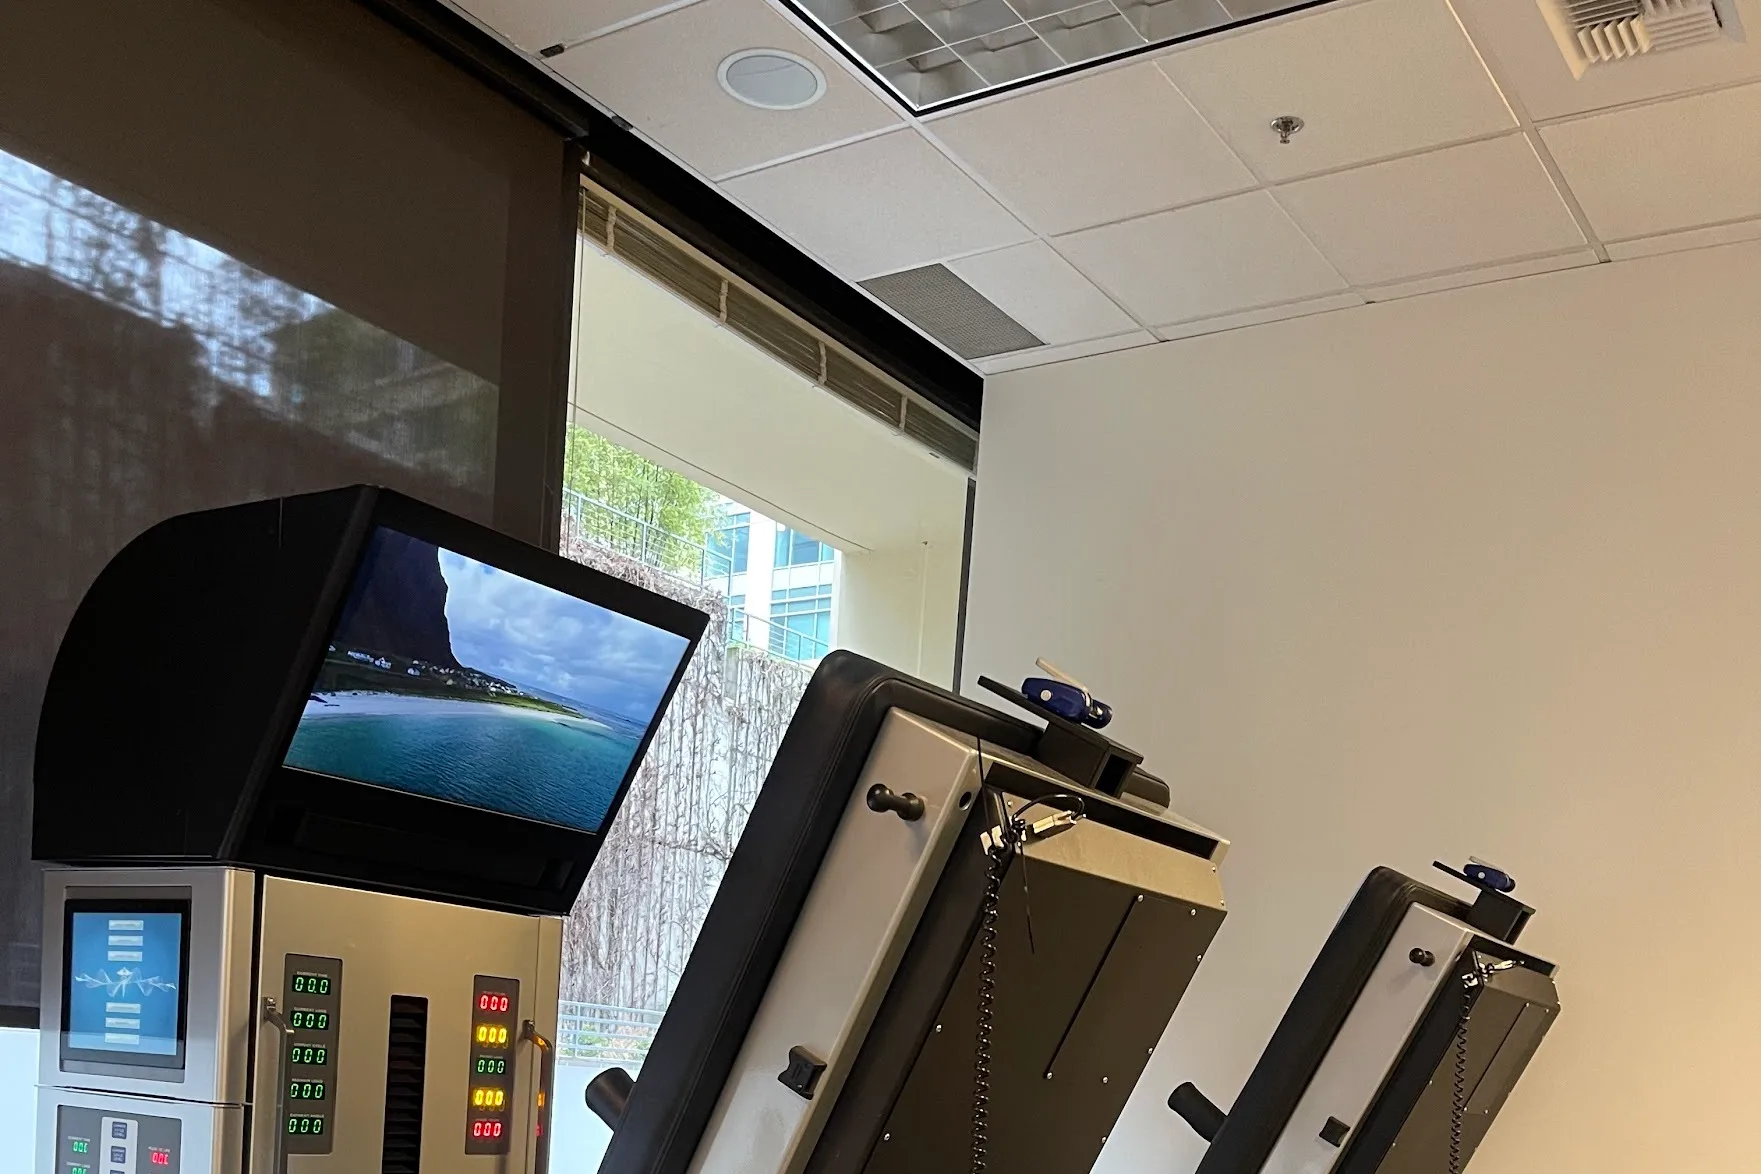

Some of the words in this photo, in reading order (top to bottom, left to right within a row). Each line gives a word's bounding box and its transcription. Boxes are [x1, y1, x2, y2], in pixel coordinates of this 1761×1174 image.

[480, 995, 508, 1012] 000
[293, 1012, 327, 1029] 000
[478, 1026, 507, 1044] 000
[292, 1048, 325, 1063] 000
[477, 1059, 505, 1074] 000
[290, 1083, 323, 1099] 000
[474, 1089, 504, 1107] 000
[288, 1118, 322, 1134] 000
[473, 1122, 502, 1137] 000
